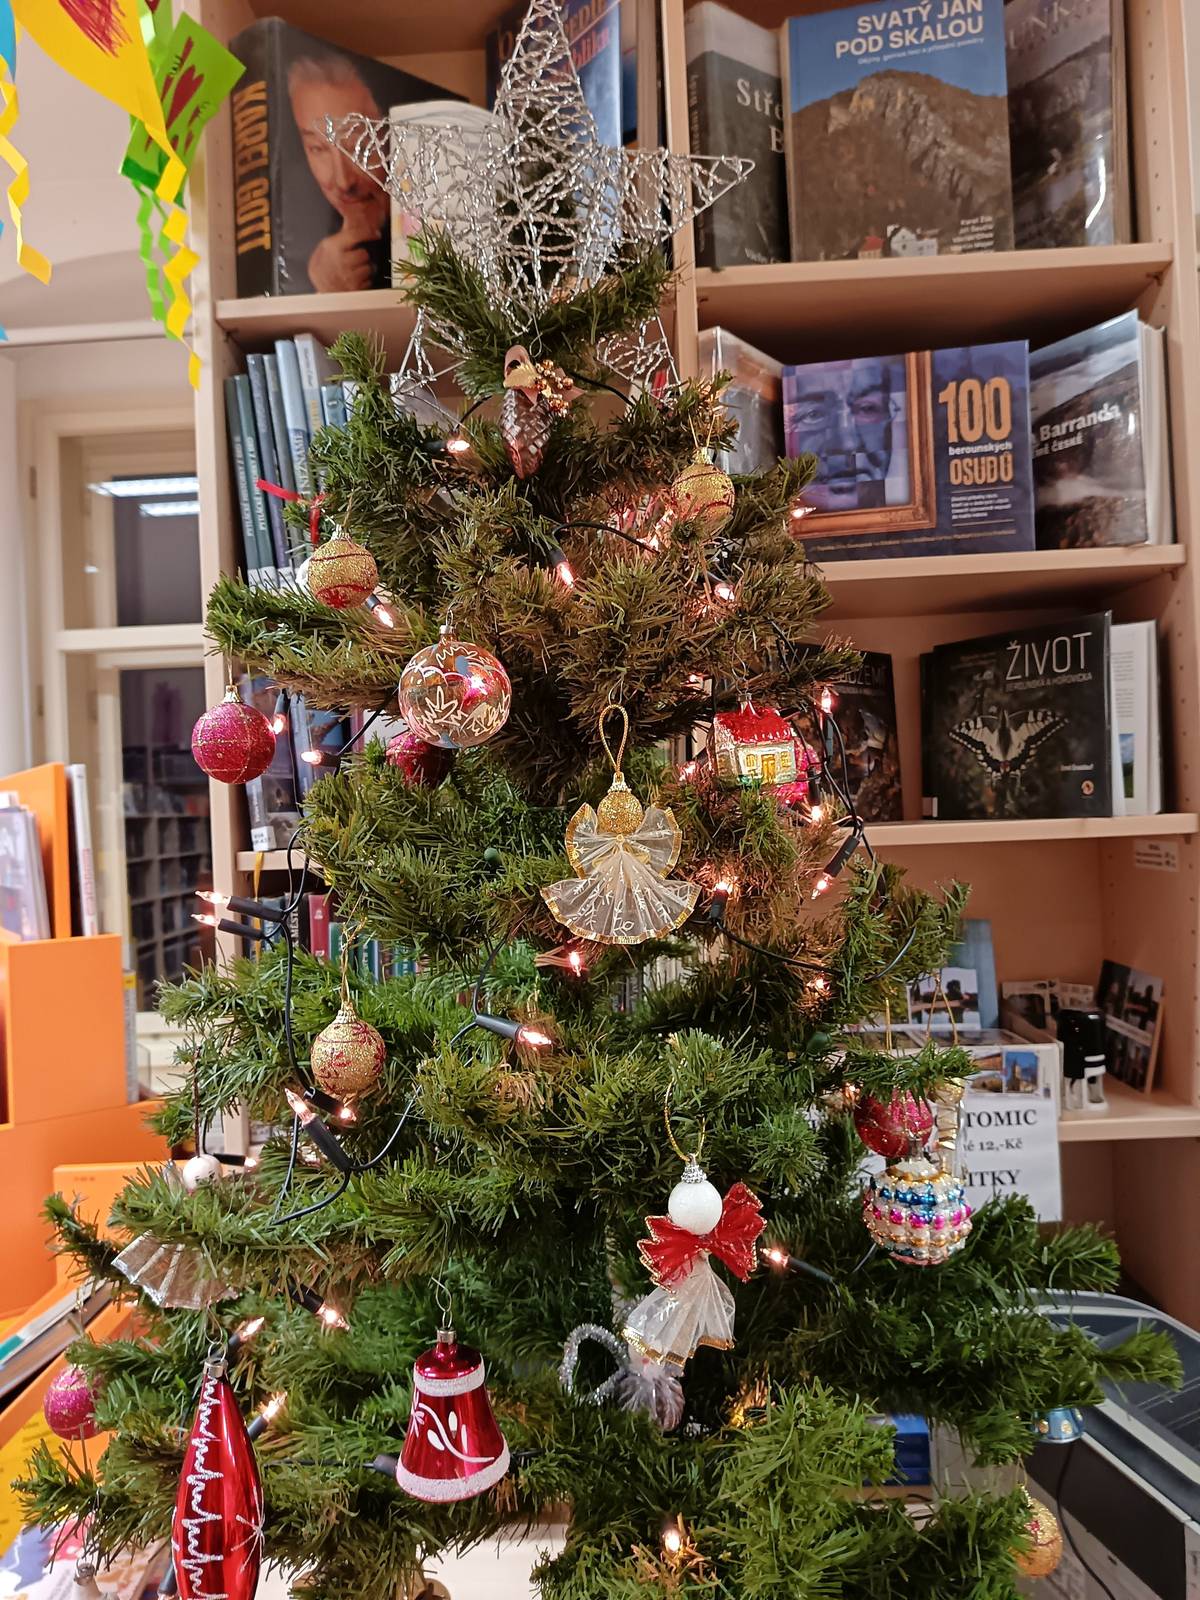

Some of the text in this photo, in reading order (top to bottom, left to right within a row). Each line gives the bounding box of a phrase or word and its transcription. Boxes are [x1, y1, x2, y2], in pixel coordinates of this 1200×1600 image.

[835, 35, 883, 59] POD
[889, 15, 984, 49] SKALOU
[857, 0, 984, 34] SVATÝ JAN
[232, 80, 272, 256] KAREL GOTT
[939, 376, 1012, 443] 100
[1040, 402, 1122, 442] Barranda
[949, 441, 1013, 457] berounských
[950, 451, 1014, 486] OSUDŮ
[1005, 631, 1093, 681] ŽIVOT
[966, 1169, 1022, 1187] ITKY
